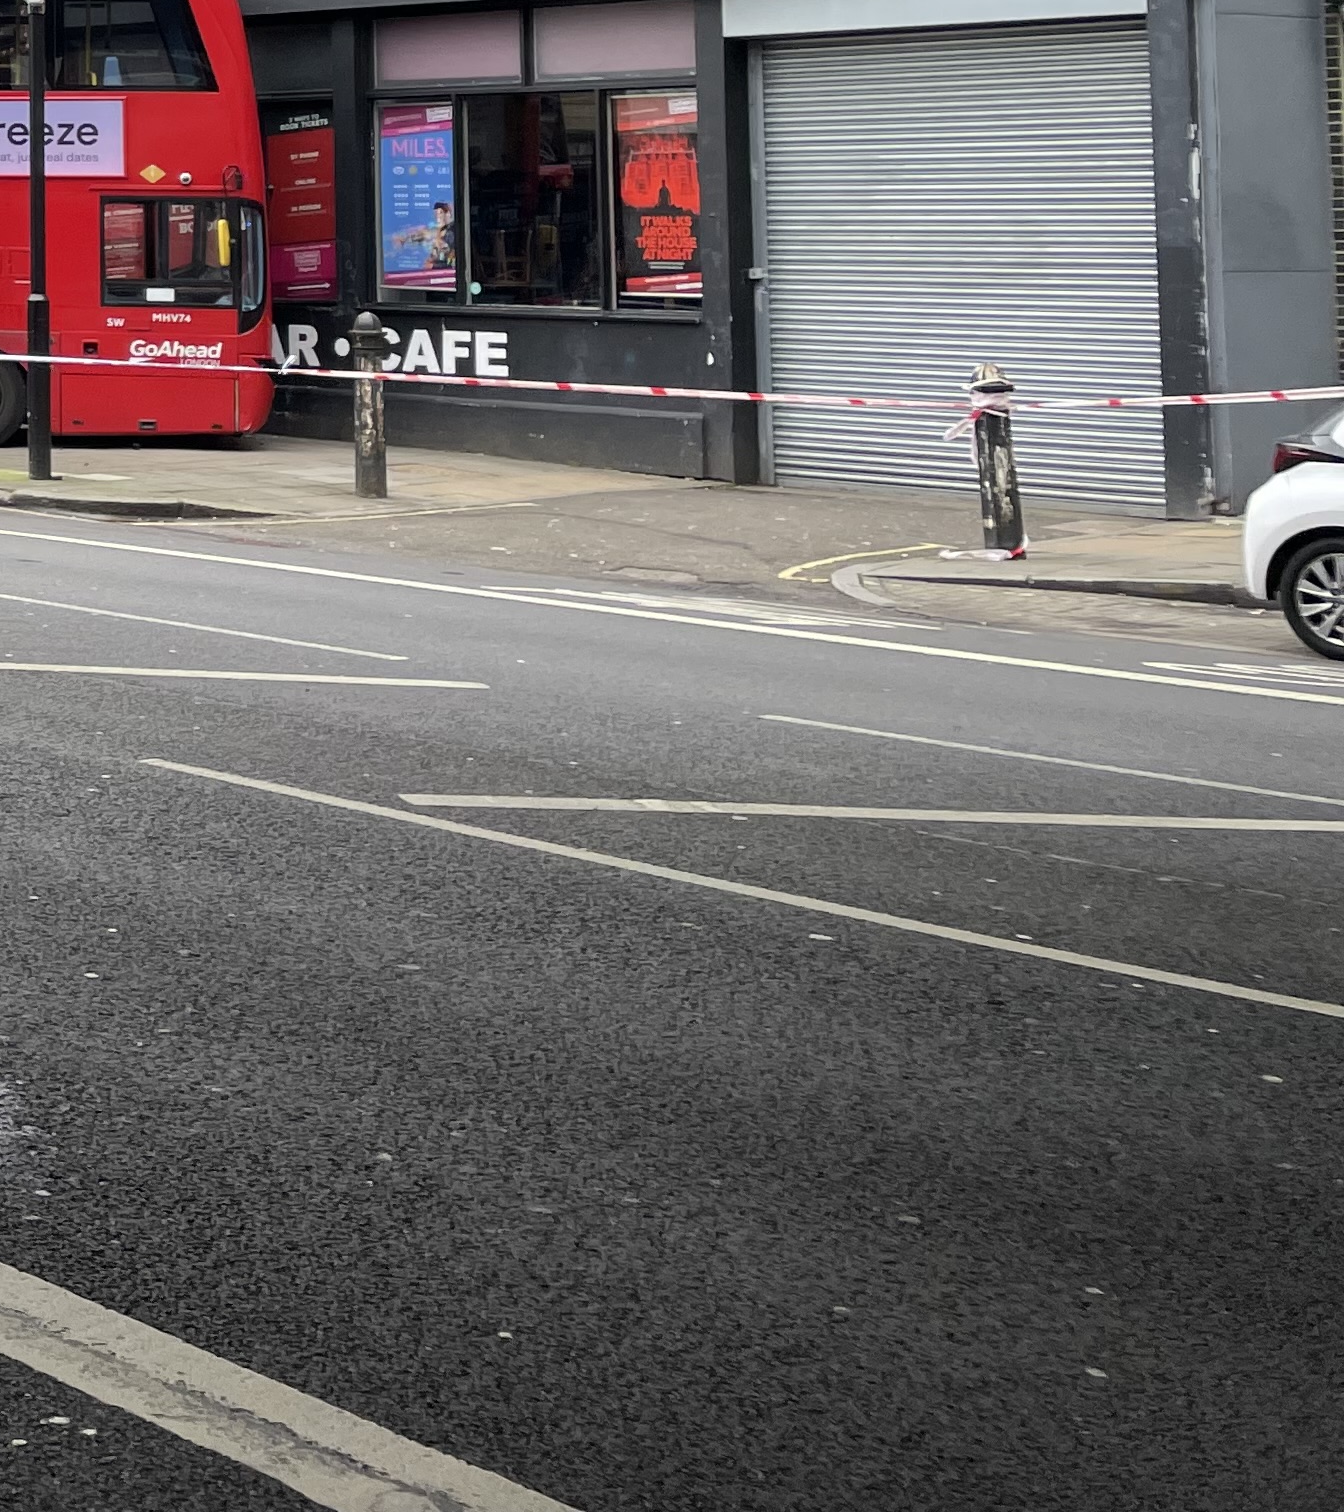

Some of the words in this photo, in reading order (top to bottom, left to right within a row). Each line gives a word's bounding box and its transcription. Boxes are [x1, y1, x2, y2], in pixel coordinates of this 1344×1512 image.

[66, 152, 99, 162] dates
[640, 216, 650, 227] IT
[651, 216, 693, 227] WALKS
[642, 226, 691, 237] AROUND
[635, 237, 657, 249] THE
[658, 237, 698, 249] HOUSE
[642, 248, 656, 260] AT
[656, 248, 694, 260] NIGHT
[106, 317, 125, 328] SW
[152, 313, 192, 323] MHV74
[129, 340, 223, 359] GoAhead
